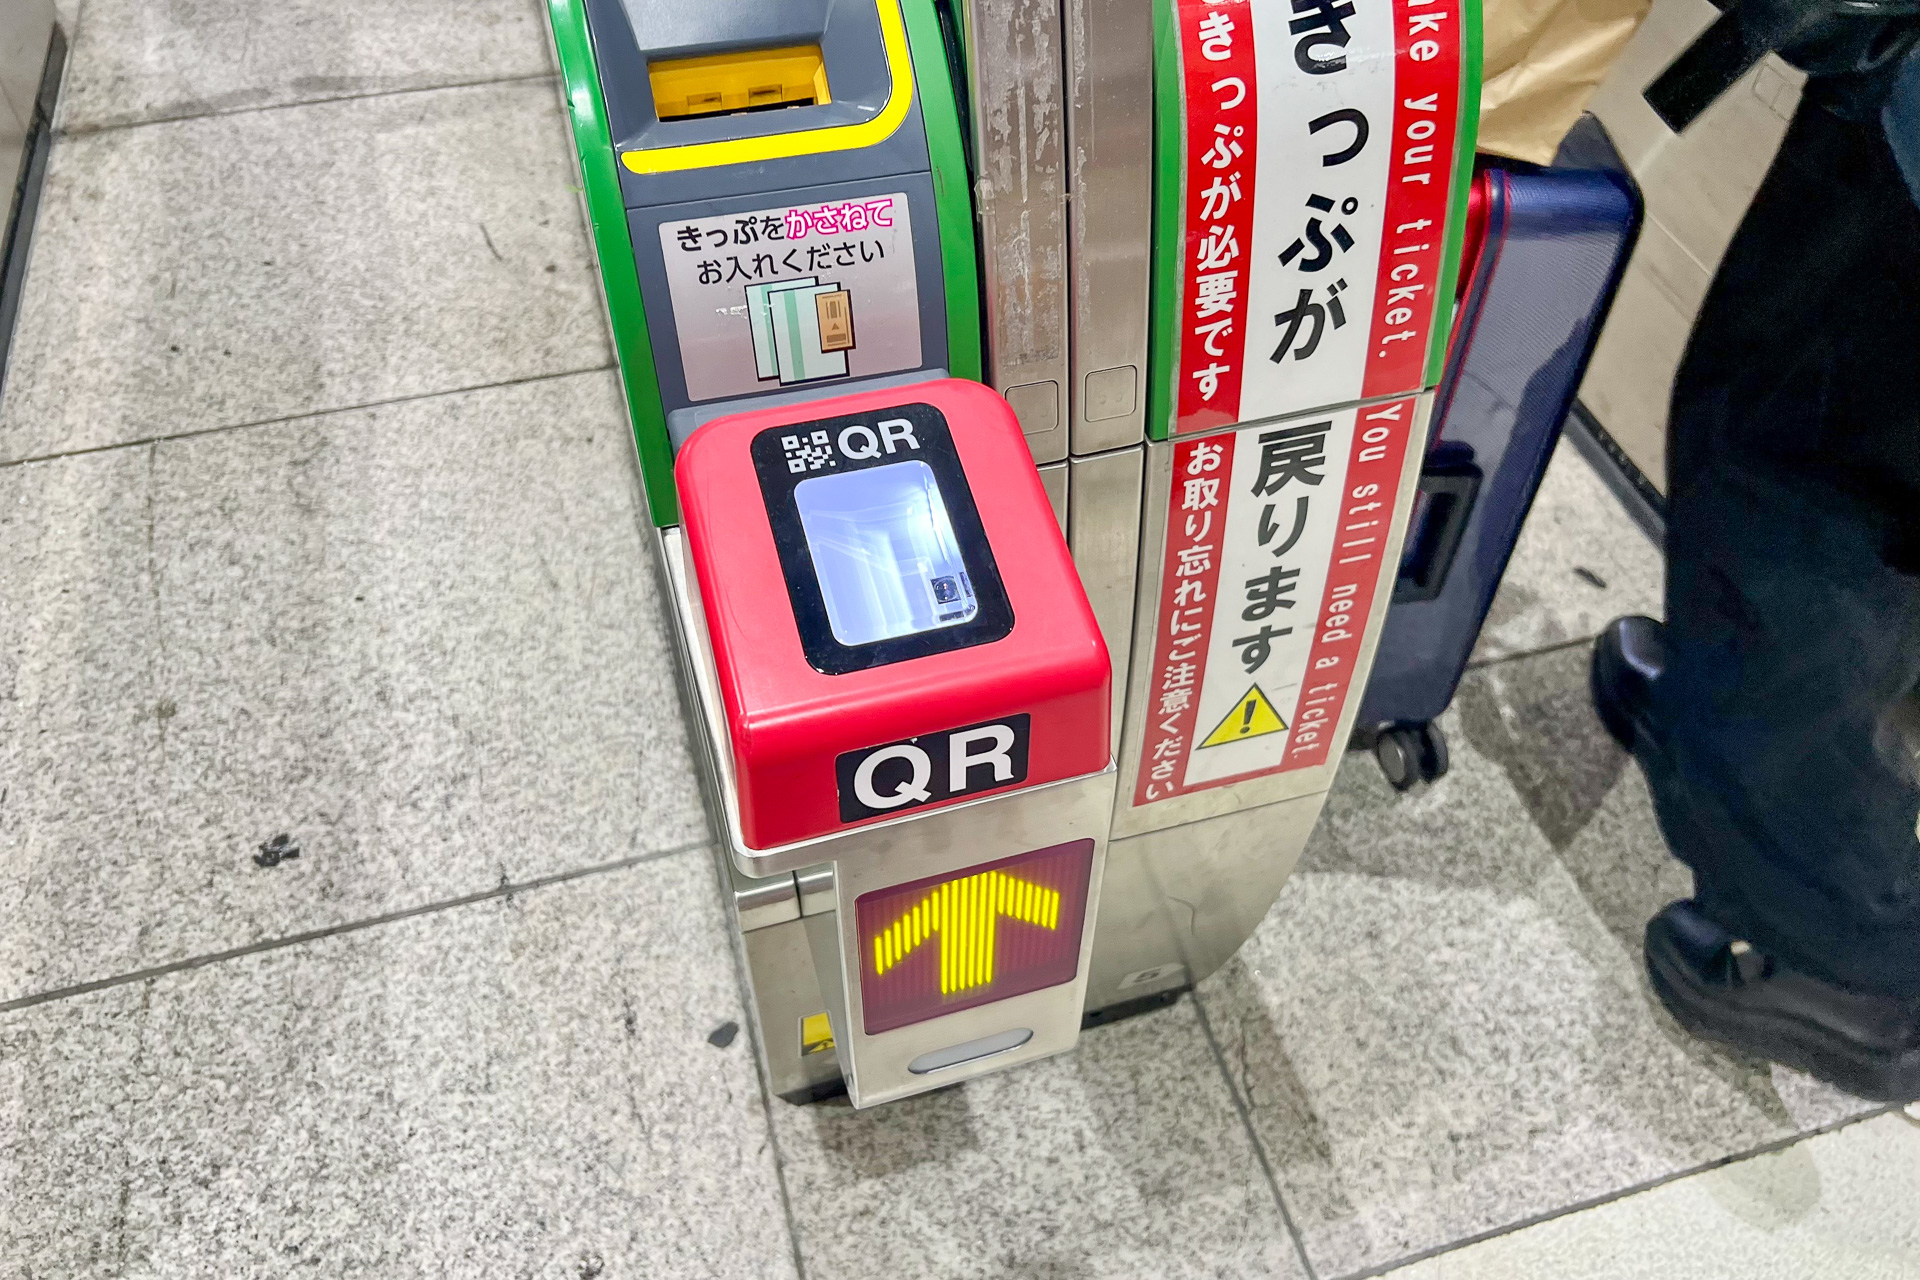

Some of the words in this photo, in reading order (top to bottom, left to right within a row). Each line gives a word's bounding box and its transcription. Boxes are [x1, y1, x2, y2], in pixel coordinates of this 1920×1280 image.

[1402, 92, 1439, 185] your
[1192, 0, 1247, 402] きっぷが必要です
[1269, 0, 1370, 364] きっぷが
[676, 198, 893, 252] きっぷをかさねて
[696, 239, 885, 285] お入れください
[1378, 217, 1432, 359] ticket.
[837, 418, 921, 460] QR
[1358, 402, 1403, 463] You
[1231, 420, 1333, 675] 戻ります
[1339, 482, 1381, 565] still
[1145, 442, 1224, 800] お取り忘れにご注意ください
[1317, 582, 1358, 644] need
[1314, 655, 1339, 670] a
[853, 723, 1015, 809] QR
